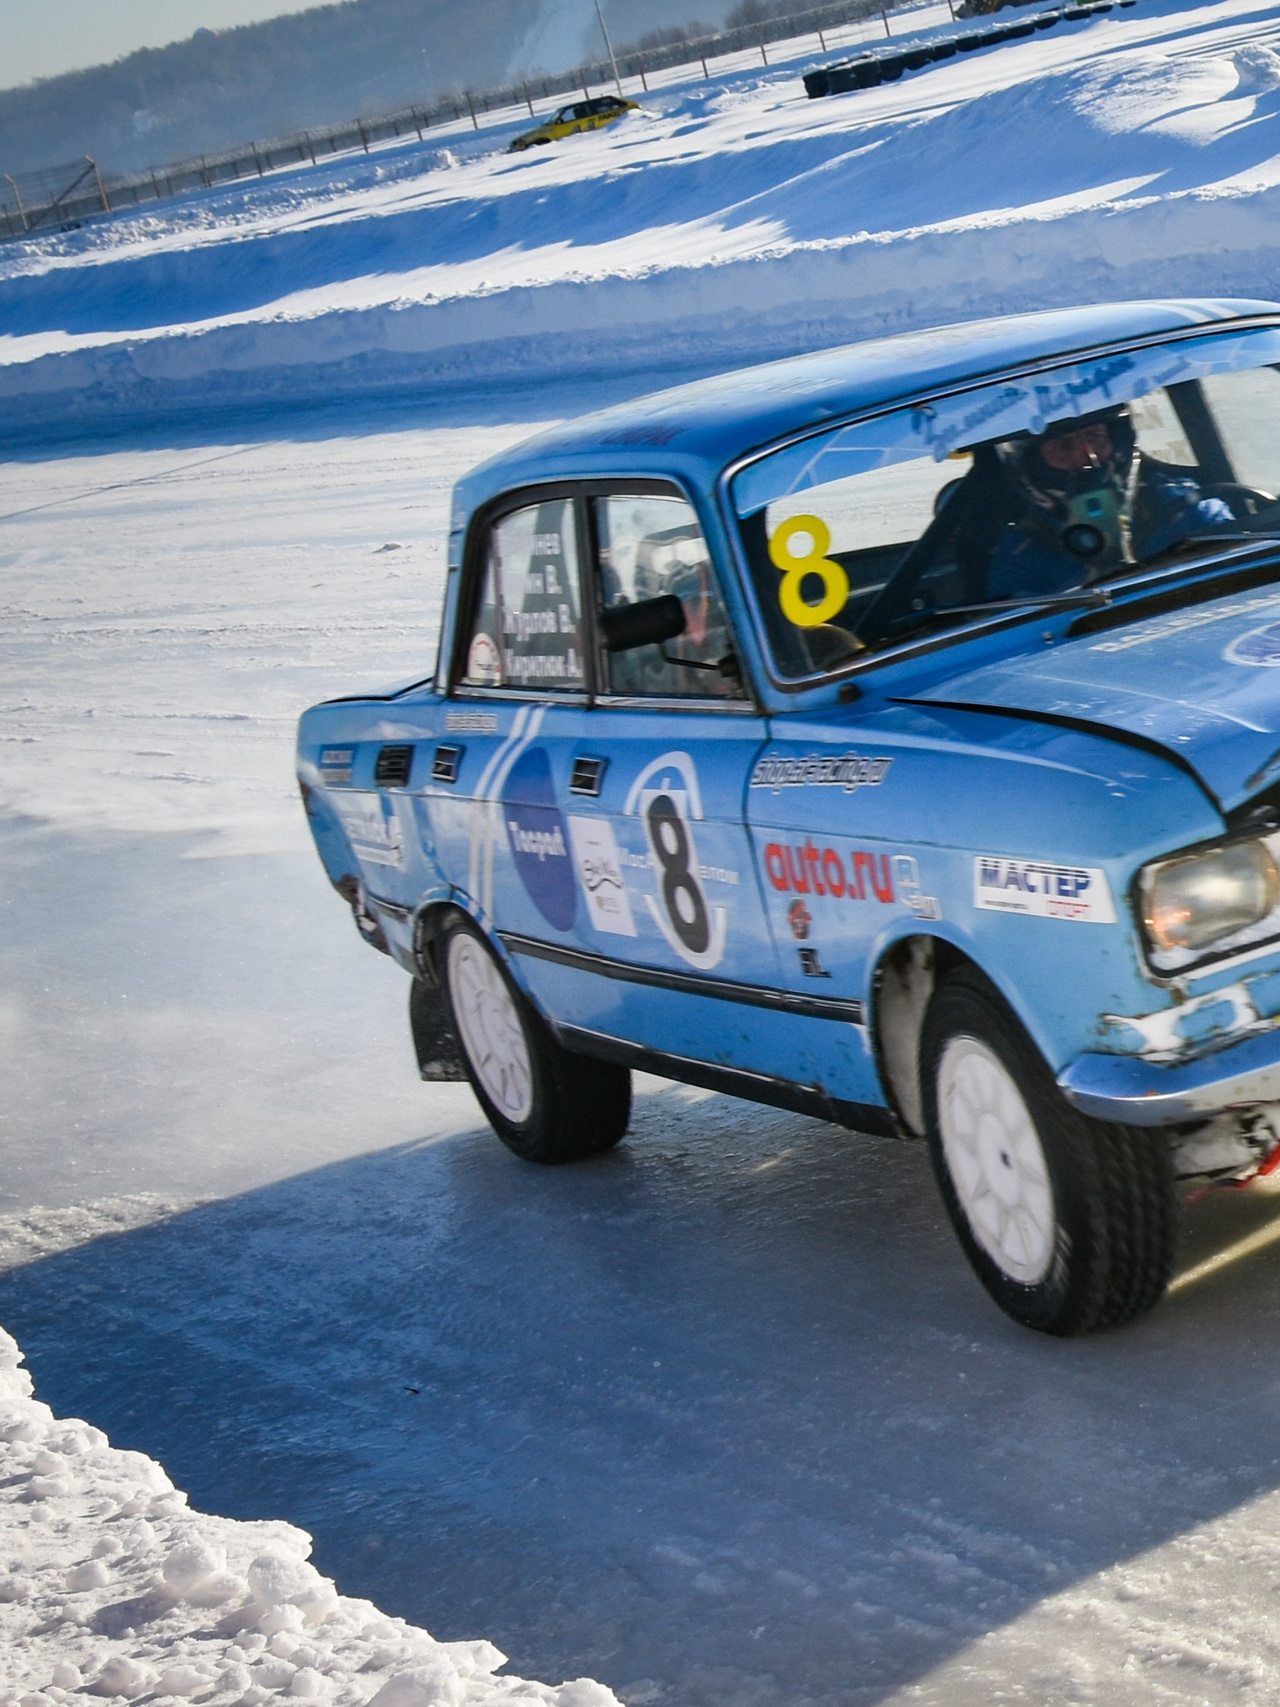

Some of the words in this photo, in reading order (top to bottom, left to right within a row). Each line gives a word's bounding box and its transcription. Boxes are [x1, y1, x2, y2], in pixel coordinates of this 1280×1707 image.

[768, 514, 848, 627] 8
[647, 794, 710, 954] 8
[765, 836, 896, 903] auto.ru
[980, 859, 1092, 898] МАСТЕР
